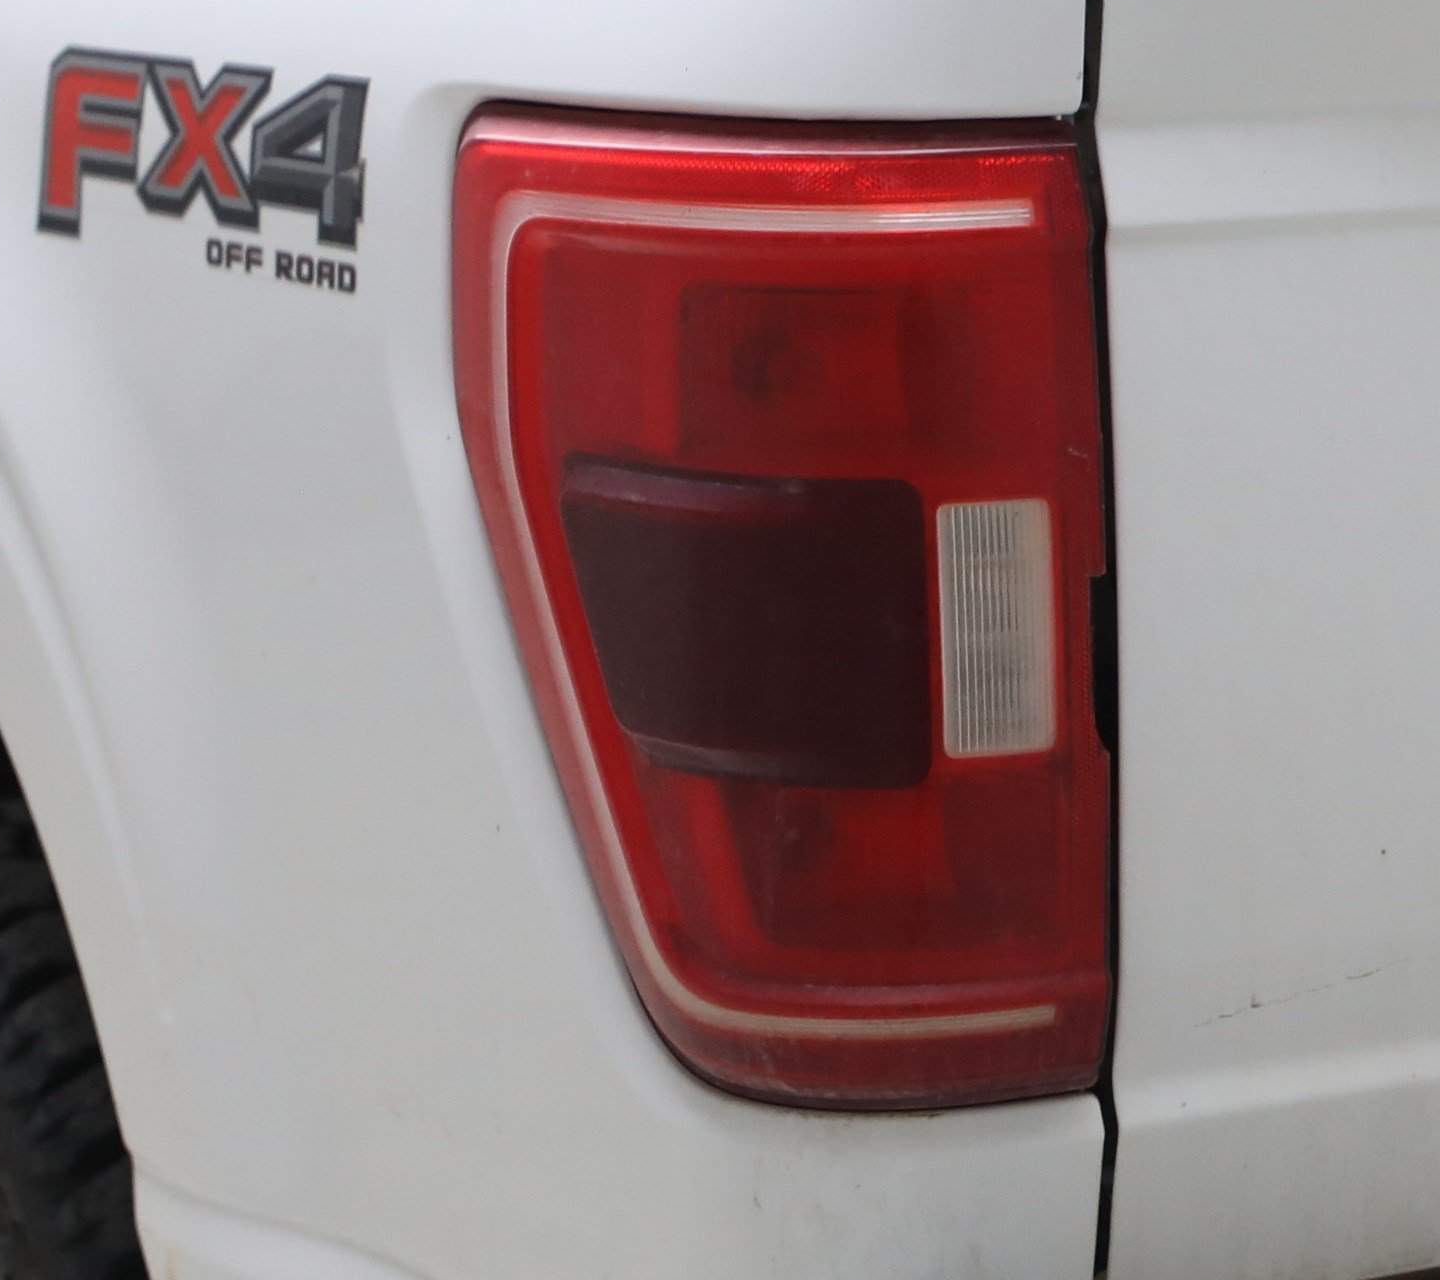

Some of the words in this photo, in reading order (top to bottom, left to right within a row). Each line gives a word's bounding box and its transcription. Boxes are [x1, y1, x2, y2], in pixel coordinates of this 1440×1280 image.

[36, 43, 371, 252] FX4
[205, 237, 263, 274] OFF
[275, 249, 358, 295] ROAD
